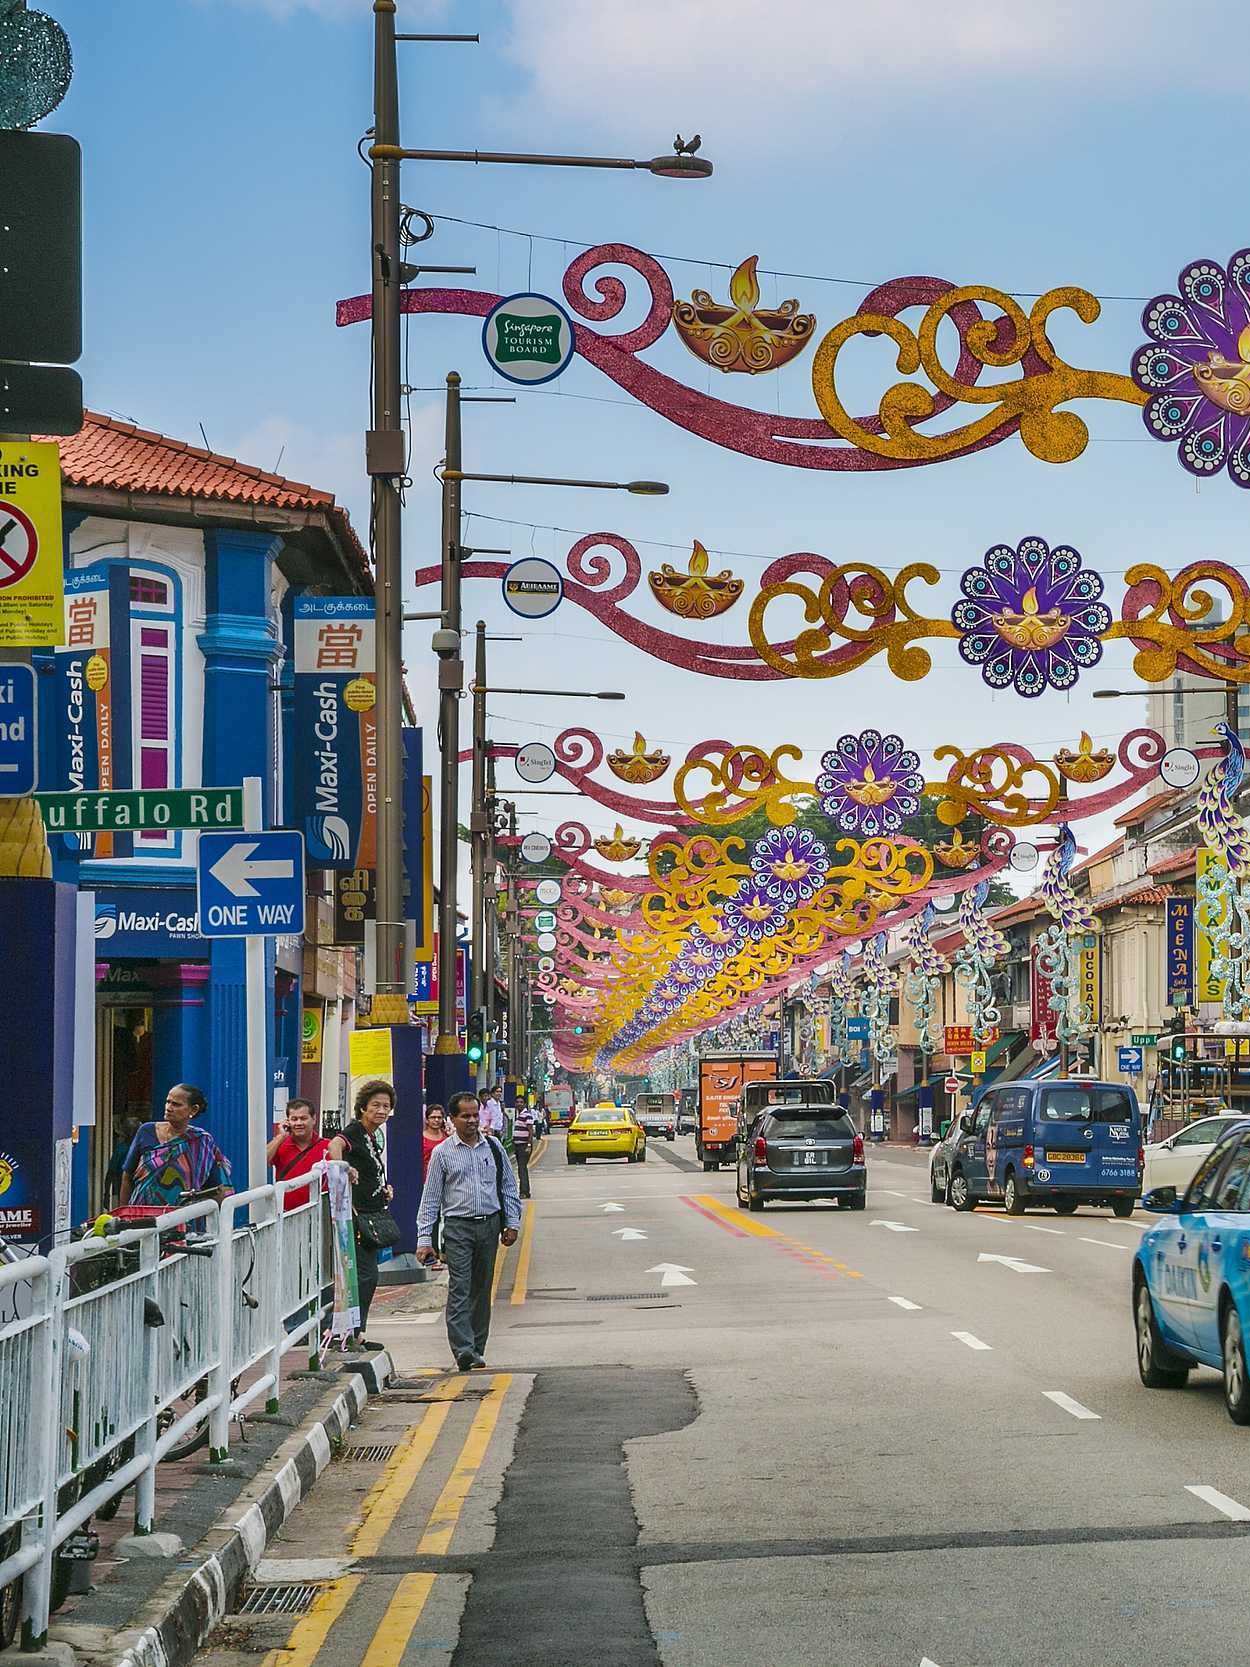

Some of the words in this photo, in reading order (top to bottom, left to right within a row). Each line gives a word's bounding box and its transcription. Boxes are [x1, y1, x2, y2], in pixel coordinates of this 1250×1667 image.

[504, 320, 553, 337] Singapore
[504, 337, 552, 345] TOURISM
[509, 345, 547, 353] BOARD
[100, 703, 109, 749] DAILY
[313, 682, 338, 812] Maxi-Cash
[366, 723, 377, 767] DAILY
[49, 797, 171, 827] uffalo
[190, 794, 232, 824] Rd
[367, 774, 377, 814] OPEN
[208, 905, 248, 927] ONE
[256, 904, 295, 926] WAY
[1085, 984, 1094, 1022] BAN
[1101, 1168, 1118, 1177] 6766
